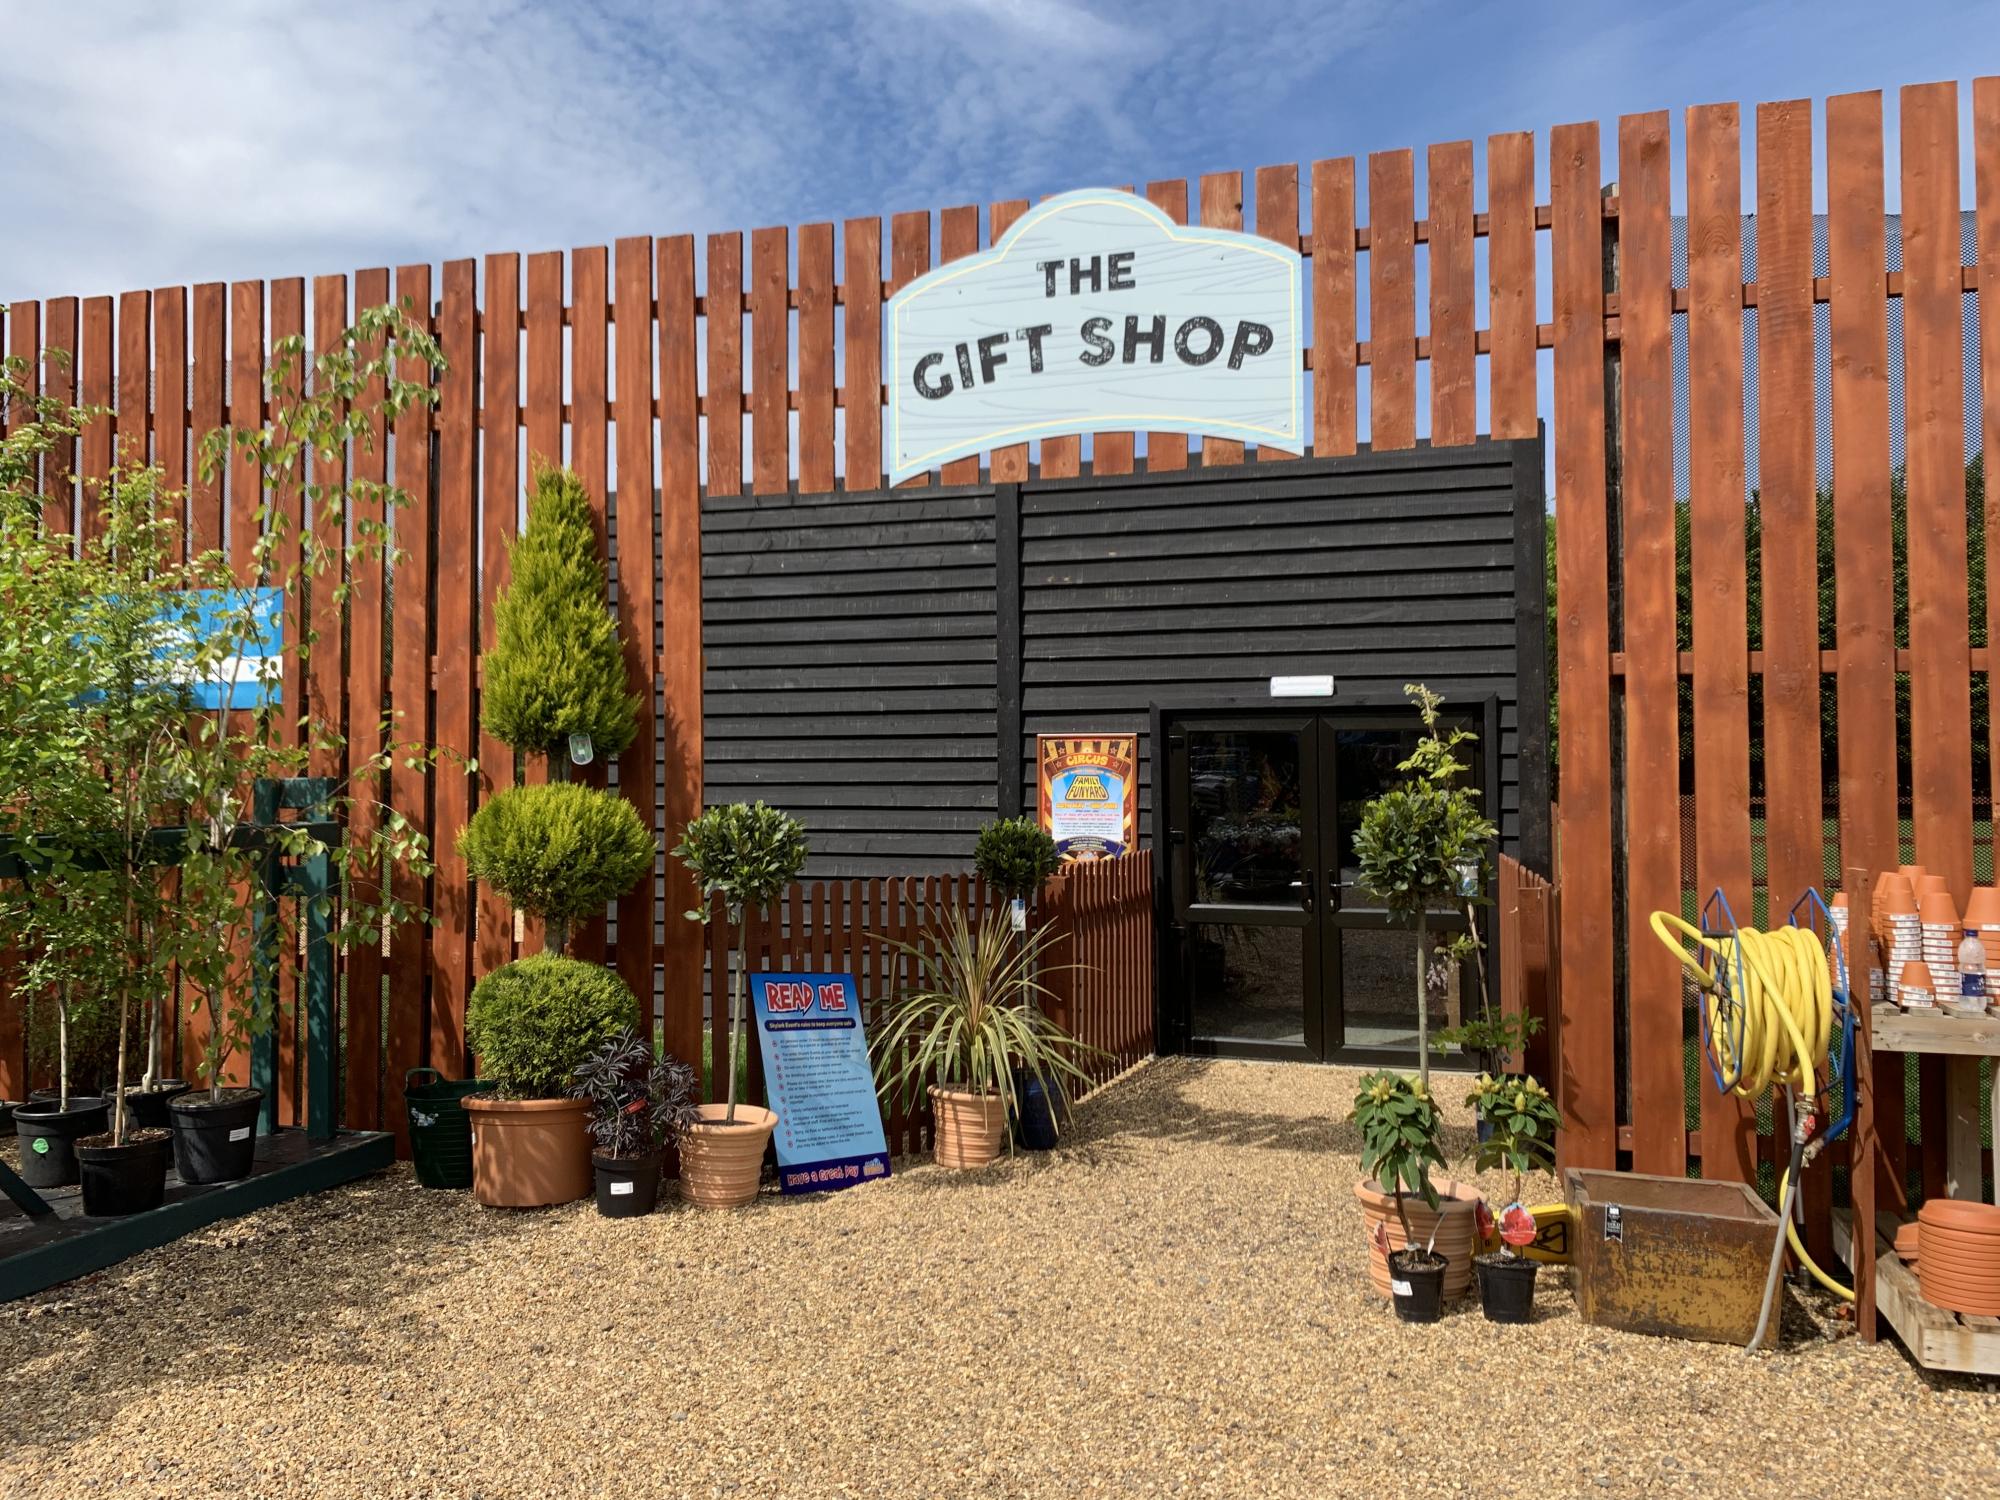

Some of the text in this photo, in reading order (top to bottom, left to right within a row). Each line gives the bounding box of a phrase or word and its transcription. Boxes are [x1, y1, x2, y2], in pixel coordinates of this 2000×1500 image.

[1036, 251, 1136, 298] THE
[912, 314, 1274, 400] GIFT SHOP
[1066, 755, 1109, 766] CIRCUS
[1074, 776, 1100, 785] FAMILY
[1067, 786, 1107, 799] FUNYARD
[765, 981, 847, 1014] READ ME
[787, 1173, 810, 1186] Have
[811, 1172, 818, 1182] a
[819, 1167, 844, 1181] Great
[845, 1165, 859, 1178] Day
